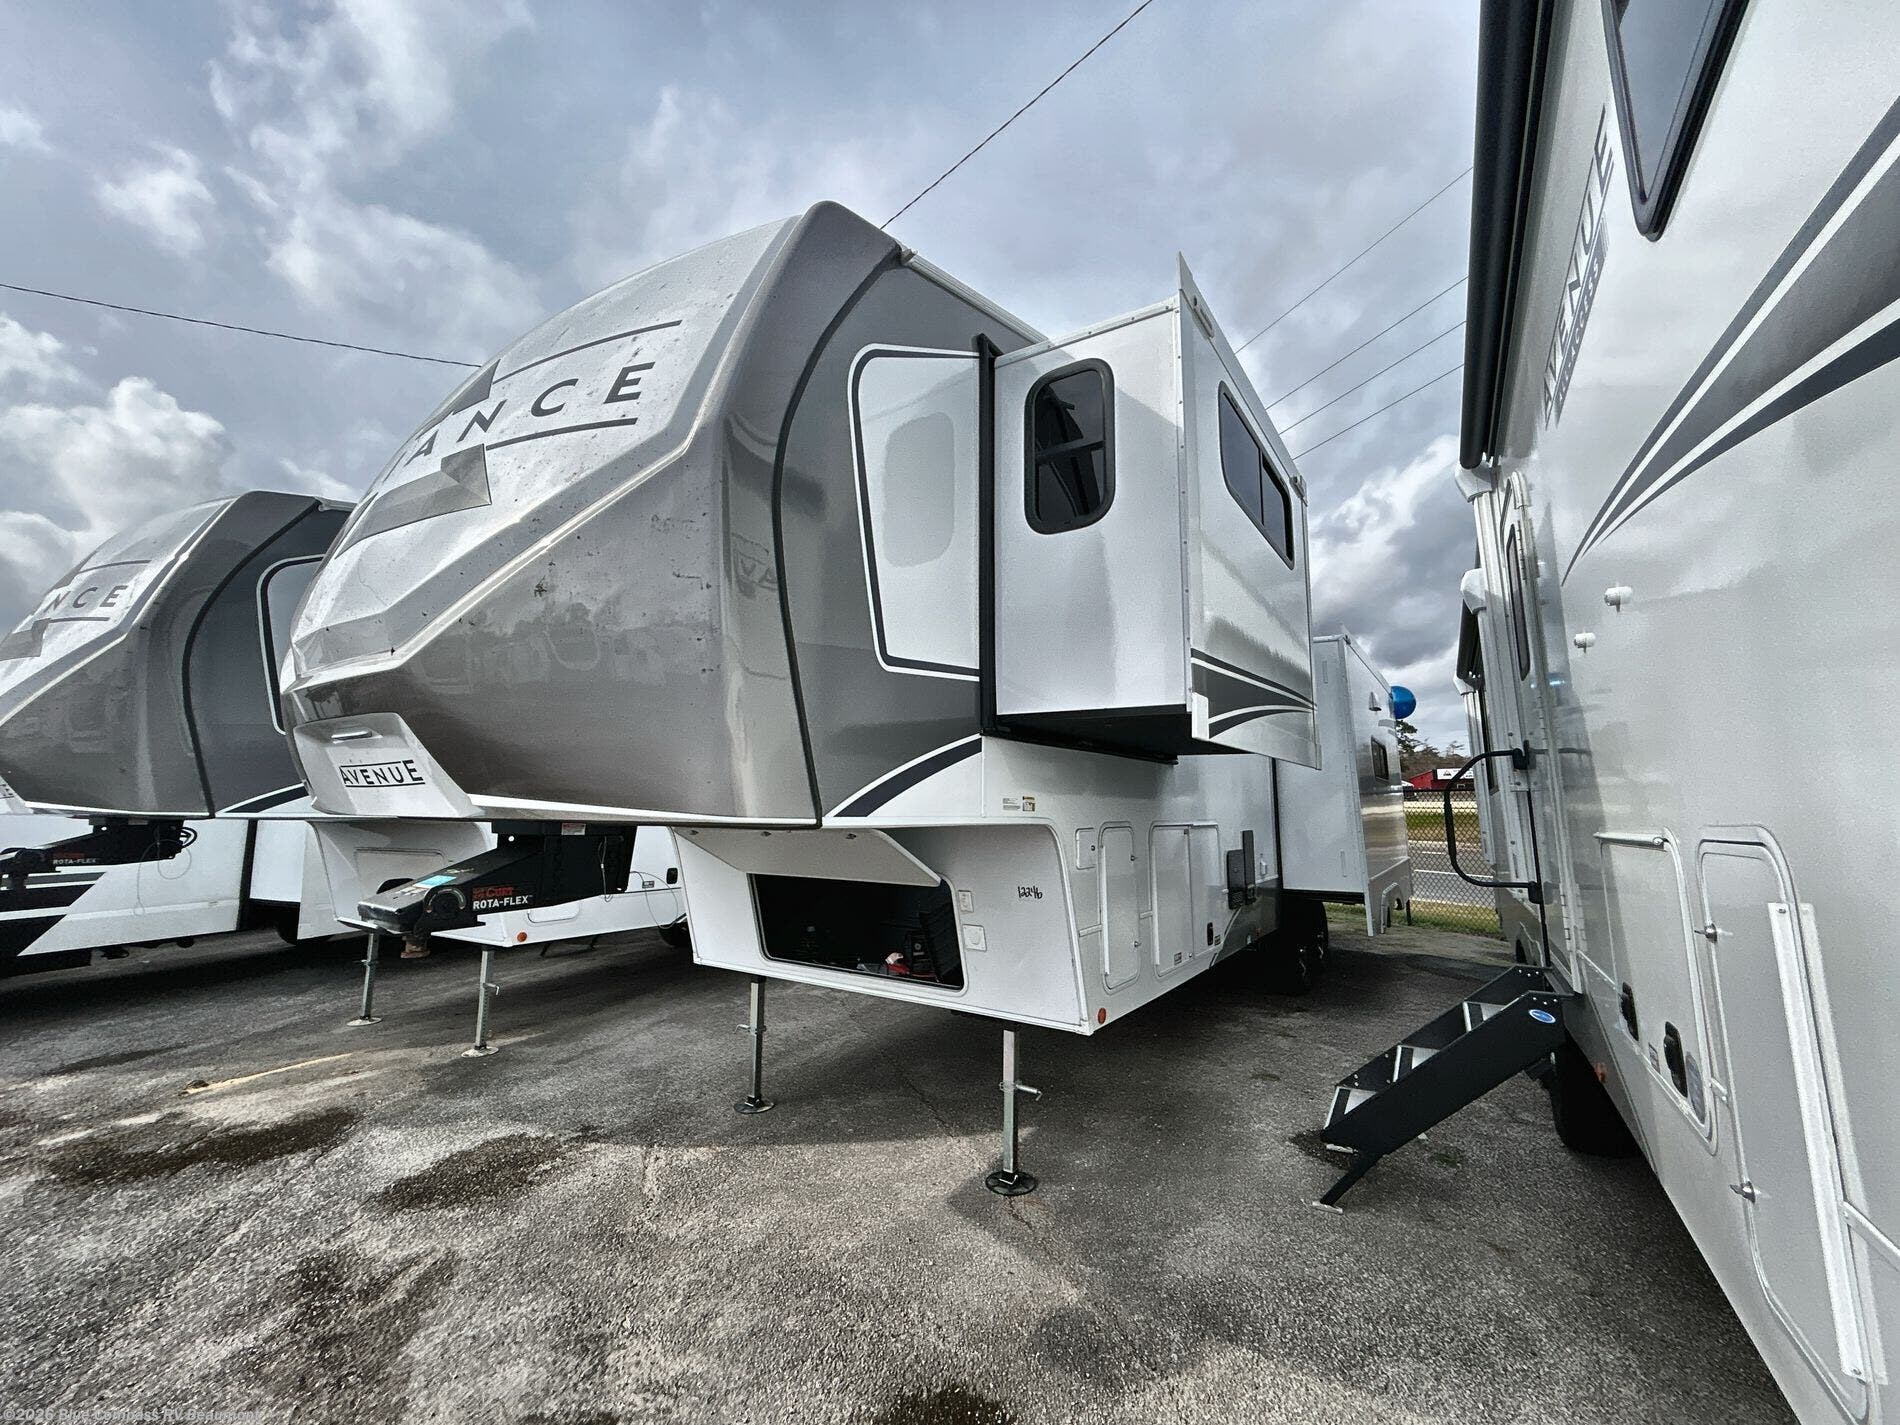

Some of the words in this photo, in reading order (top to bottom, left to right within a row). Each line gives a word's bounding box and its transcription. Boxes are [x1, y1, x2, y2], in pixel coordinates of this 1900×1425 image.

[1543, 102, 1613, 422] AVENUE
[339, 760, 424, 785] AVENUE
[472, 895, 529, 910] ROTA-FLEX
